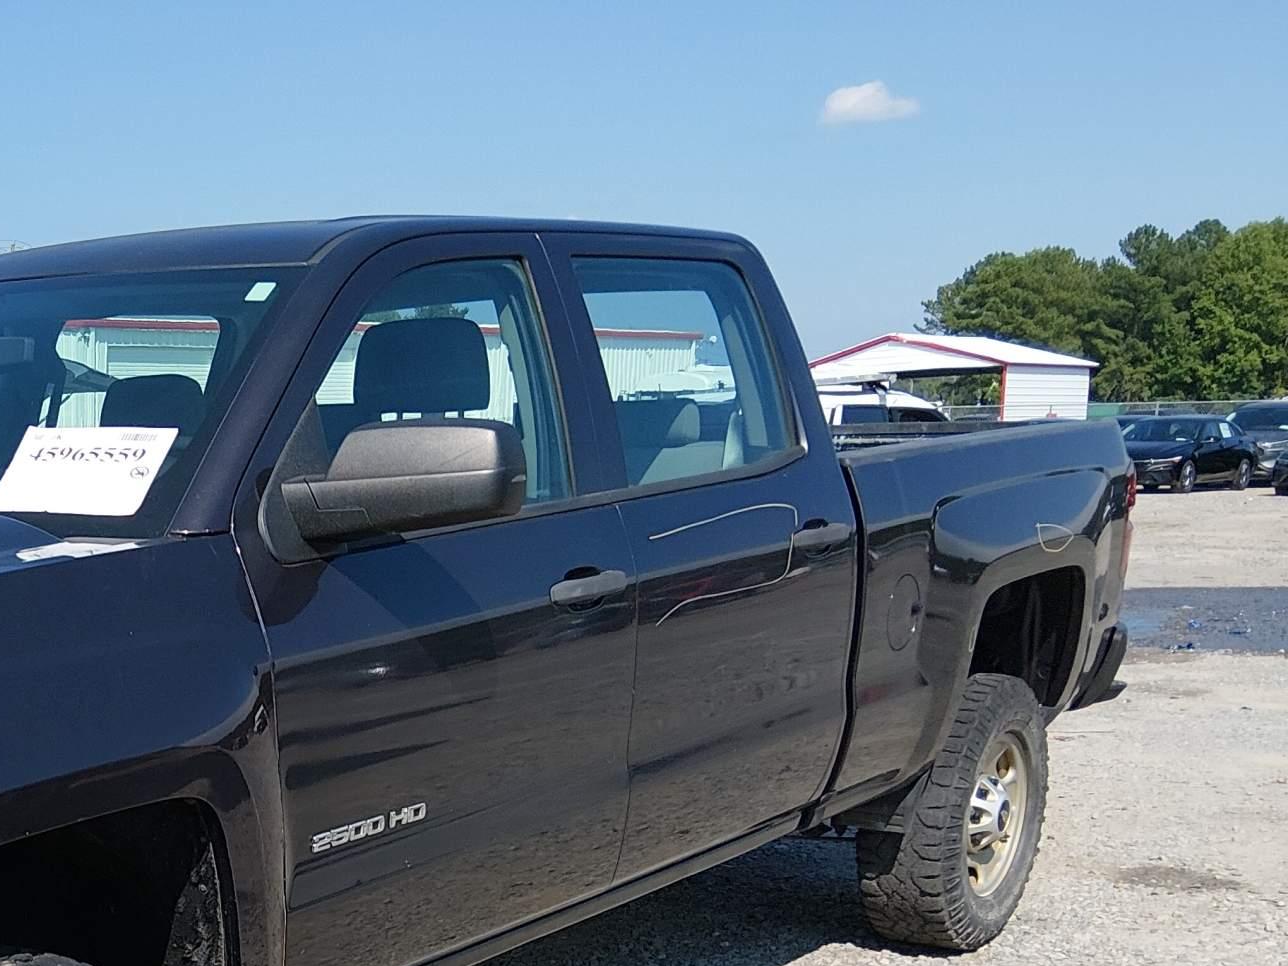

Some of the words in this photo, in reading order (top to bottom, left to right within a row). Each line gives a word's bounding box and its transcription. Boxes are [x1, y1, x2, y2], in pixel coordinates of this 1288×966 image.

[30, 447, 146, 462] 45965559
[312, 815, 385, 853] 2500
[389, 803, 426, 828] HD
